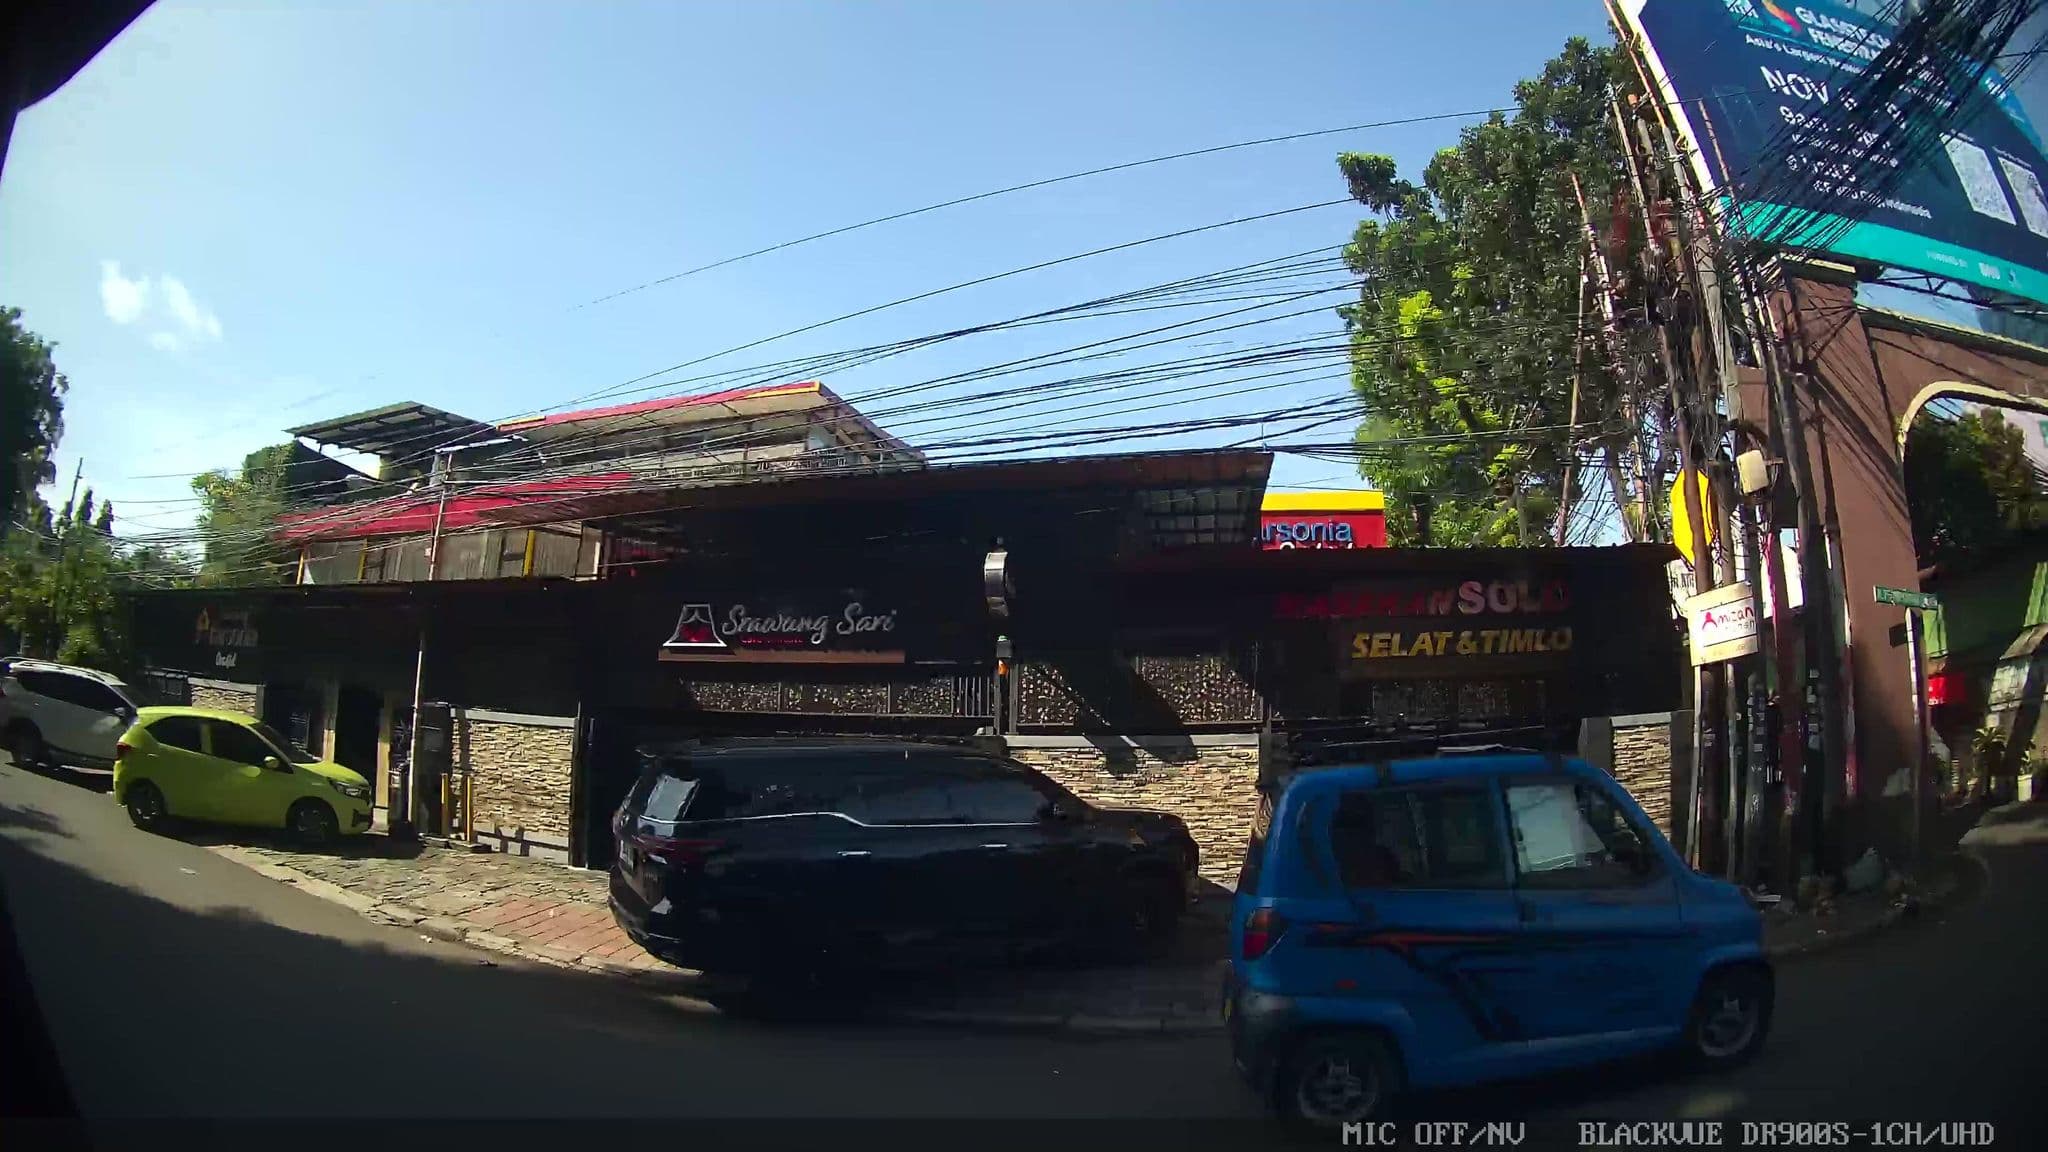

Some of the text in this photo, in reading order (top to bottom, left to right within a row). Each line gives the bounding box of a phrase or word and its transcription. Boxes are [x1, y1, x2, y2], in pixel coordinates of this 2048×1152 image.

[1760, 65, 1830, 105] NOV
[836, 602, 898, 636] Sari
[1351, 630, 1455, 660] SELAT
